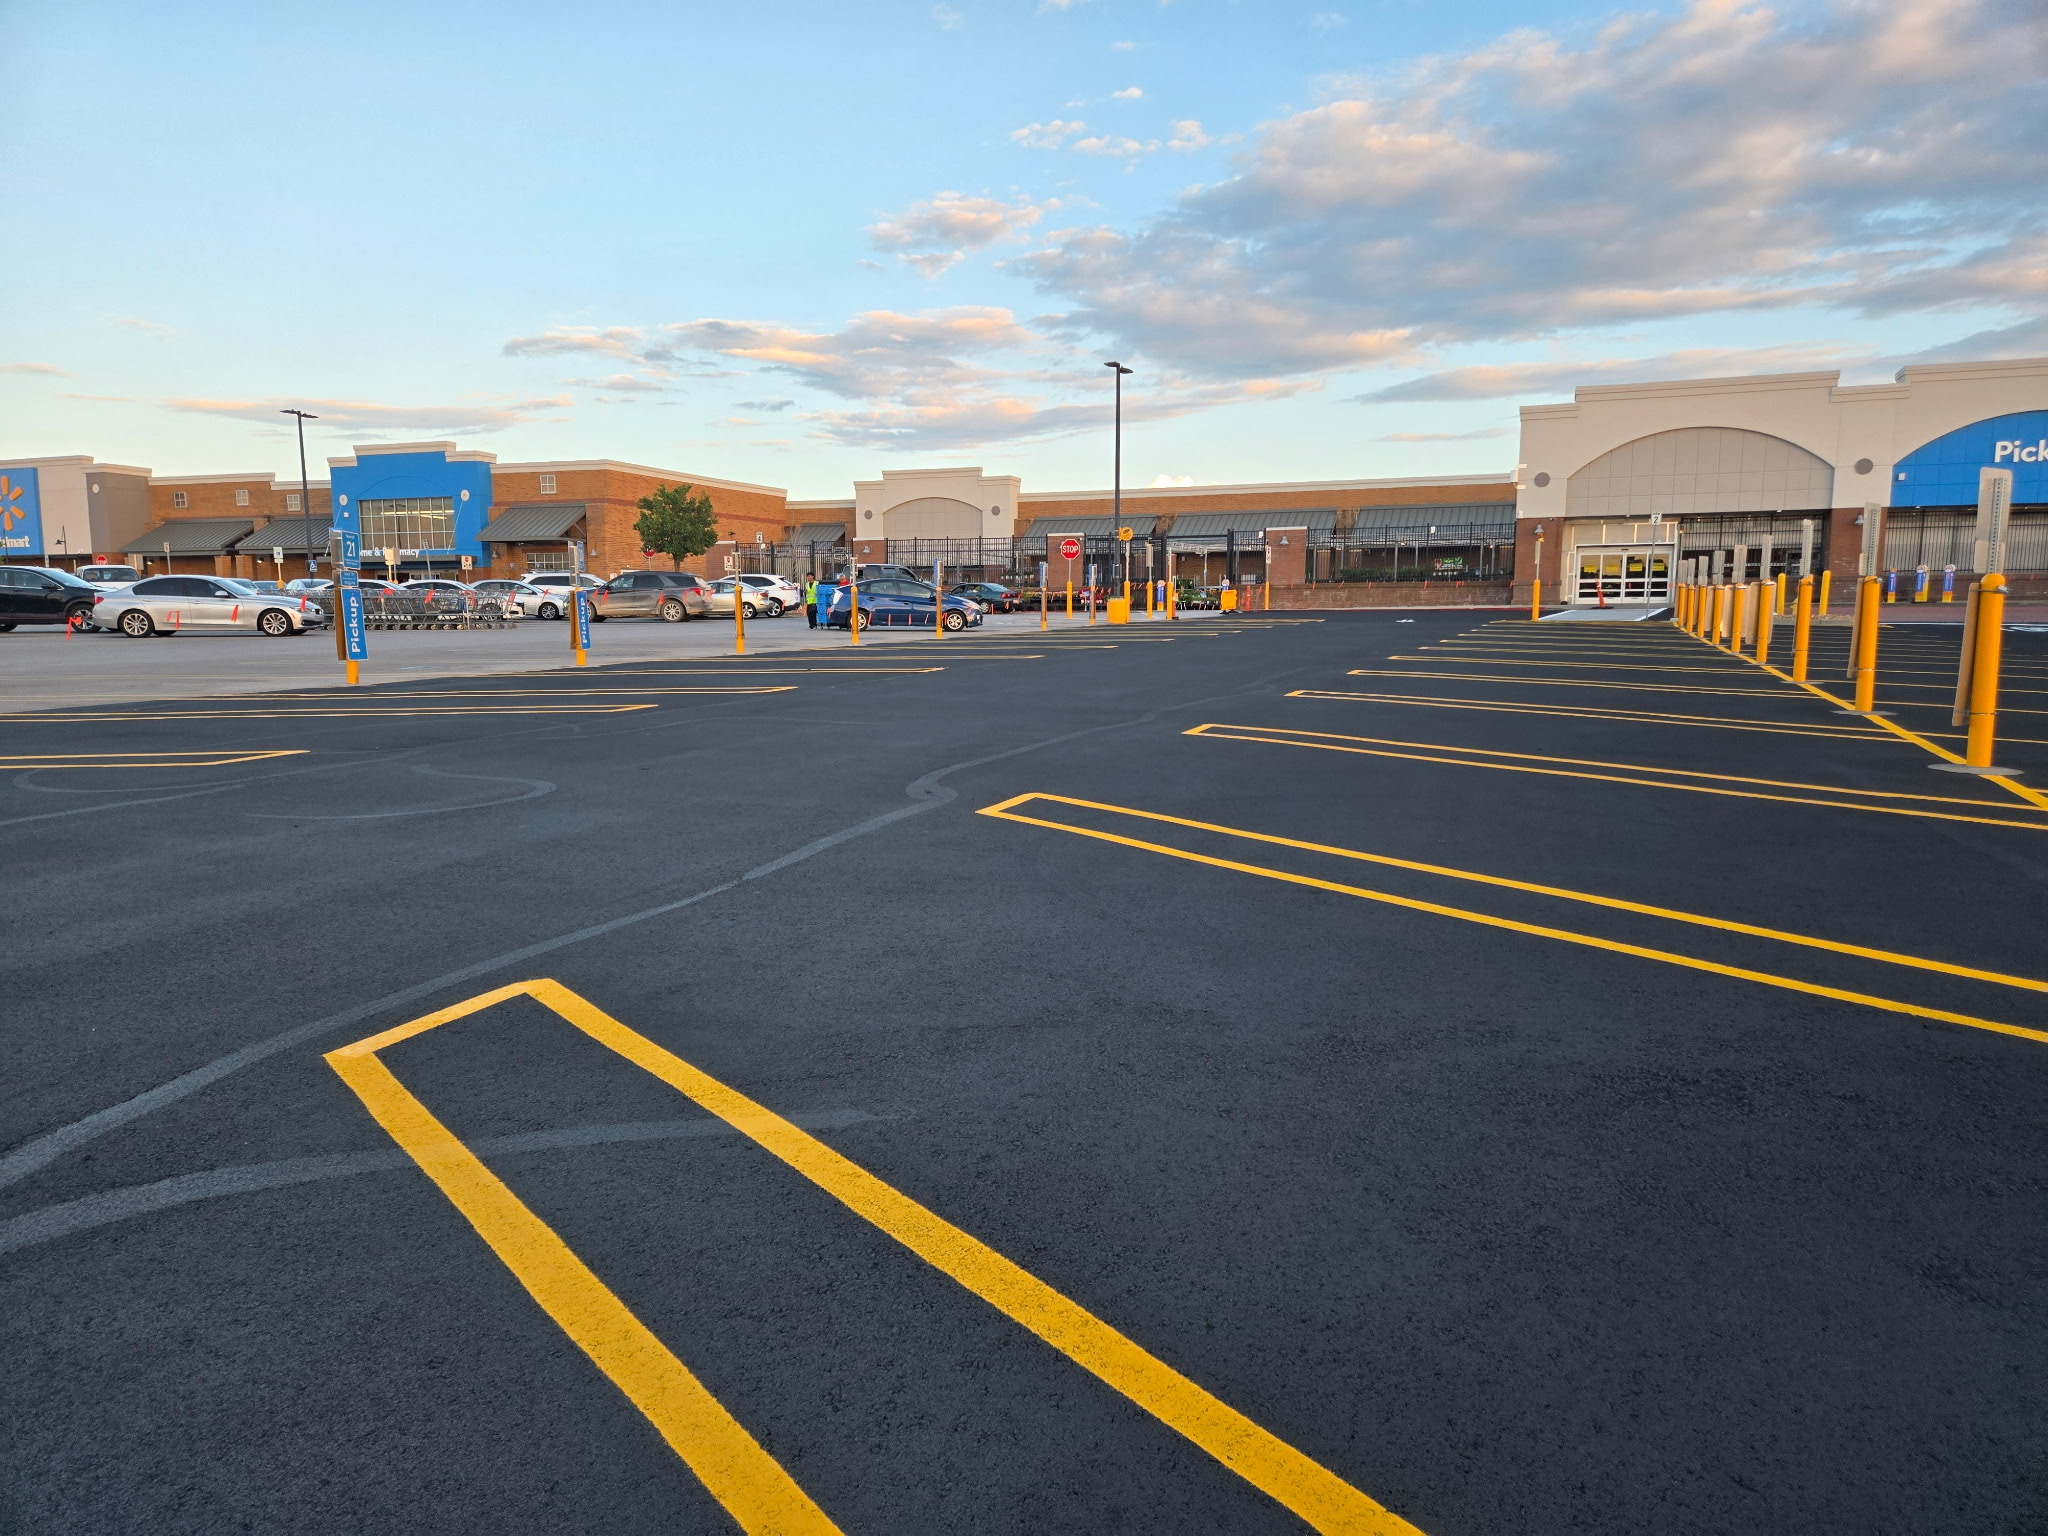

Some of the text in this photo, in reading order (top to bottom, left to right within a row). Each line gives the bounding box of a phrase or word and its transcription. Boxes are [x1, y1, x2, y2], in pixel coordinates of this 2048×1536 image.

[1653, 515, 1659, 524] 2
[346, 541, 356, 557] 21
[374, 546, 381, 557] &
[1062, 545, 1078, 554] STOP
[349, 596, 361, 653] Pickup
[580, 597, 588, 643] Pickup
